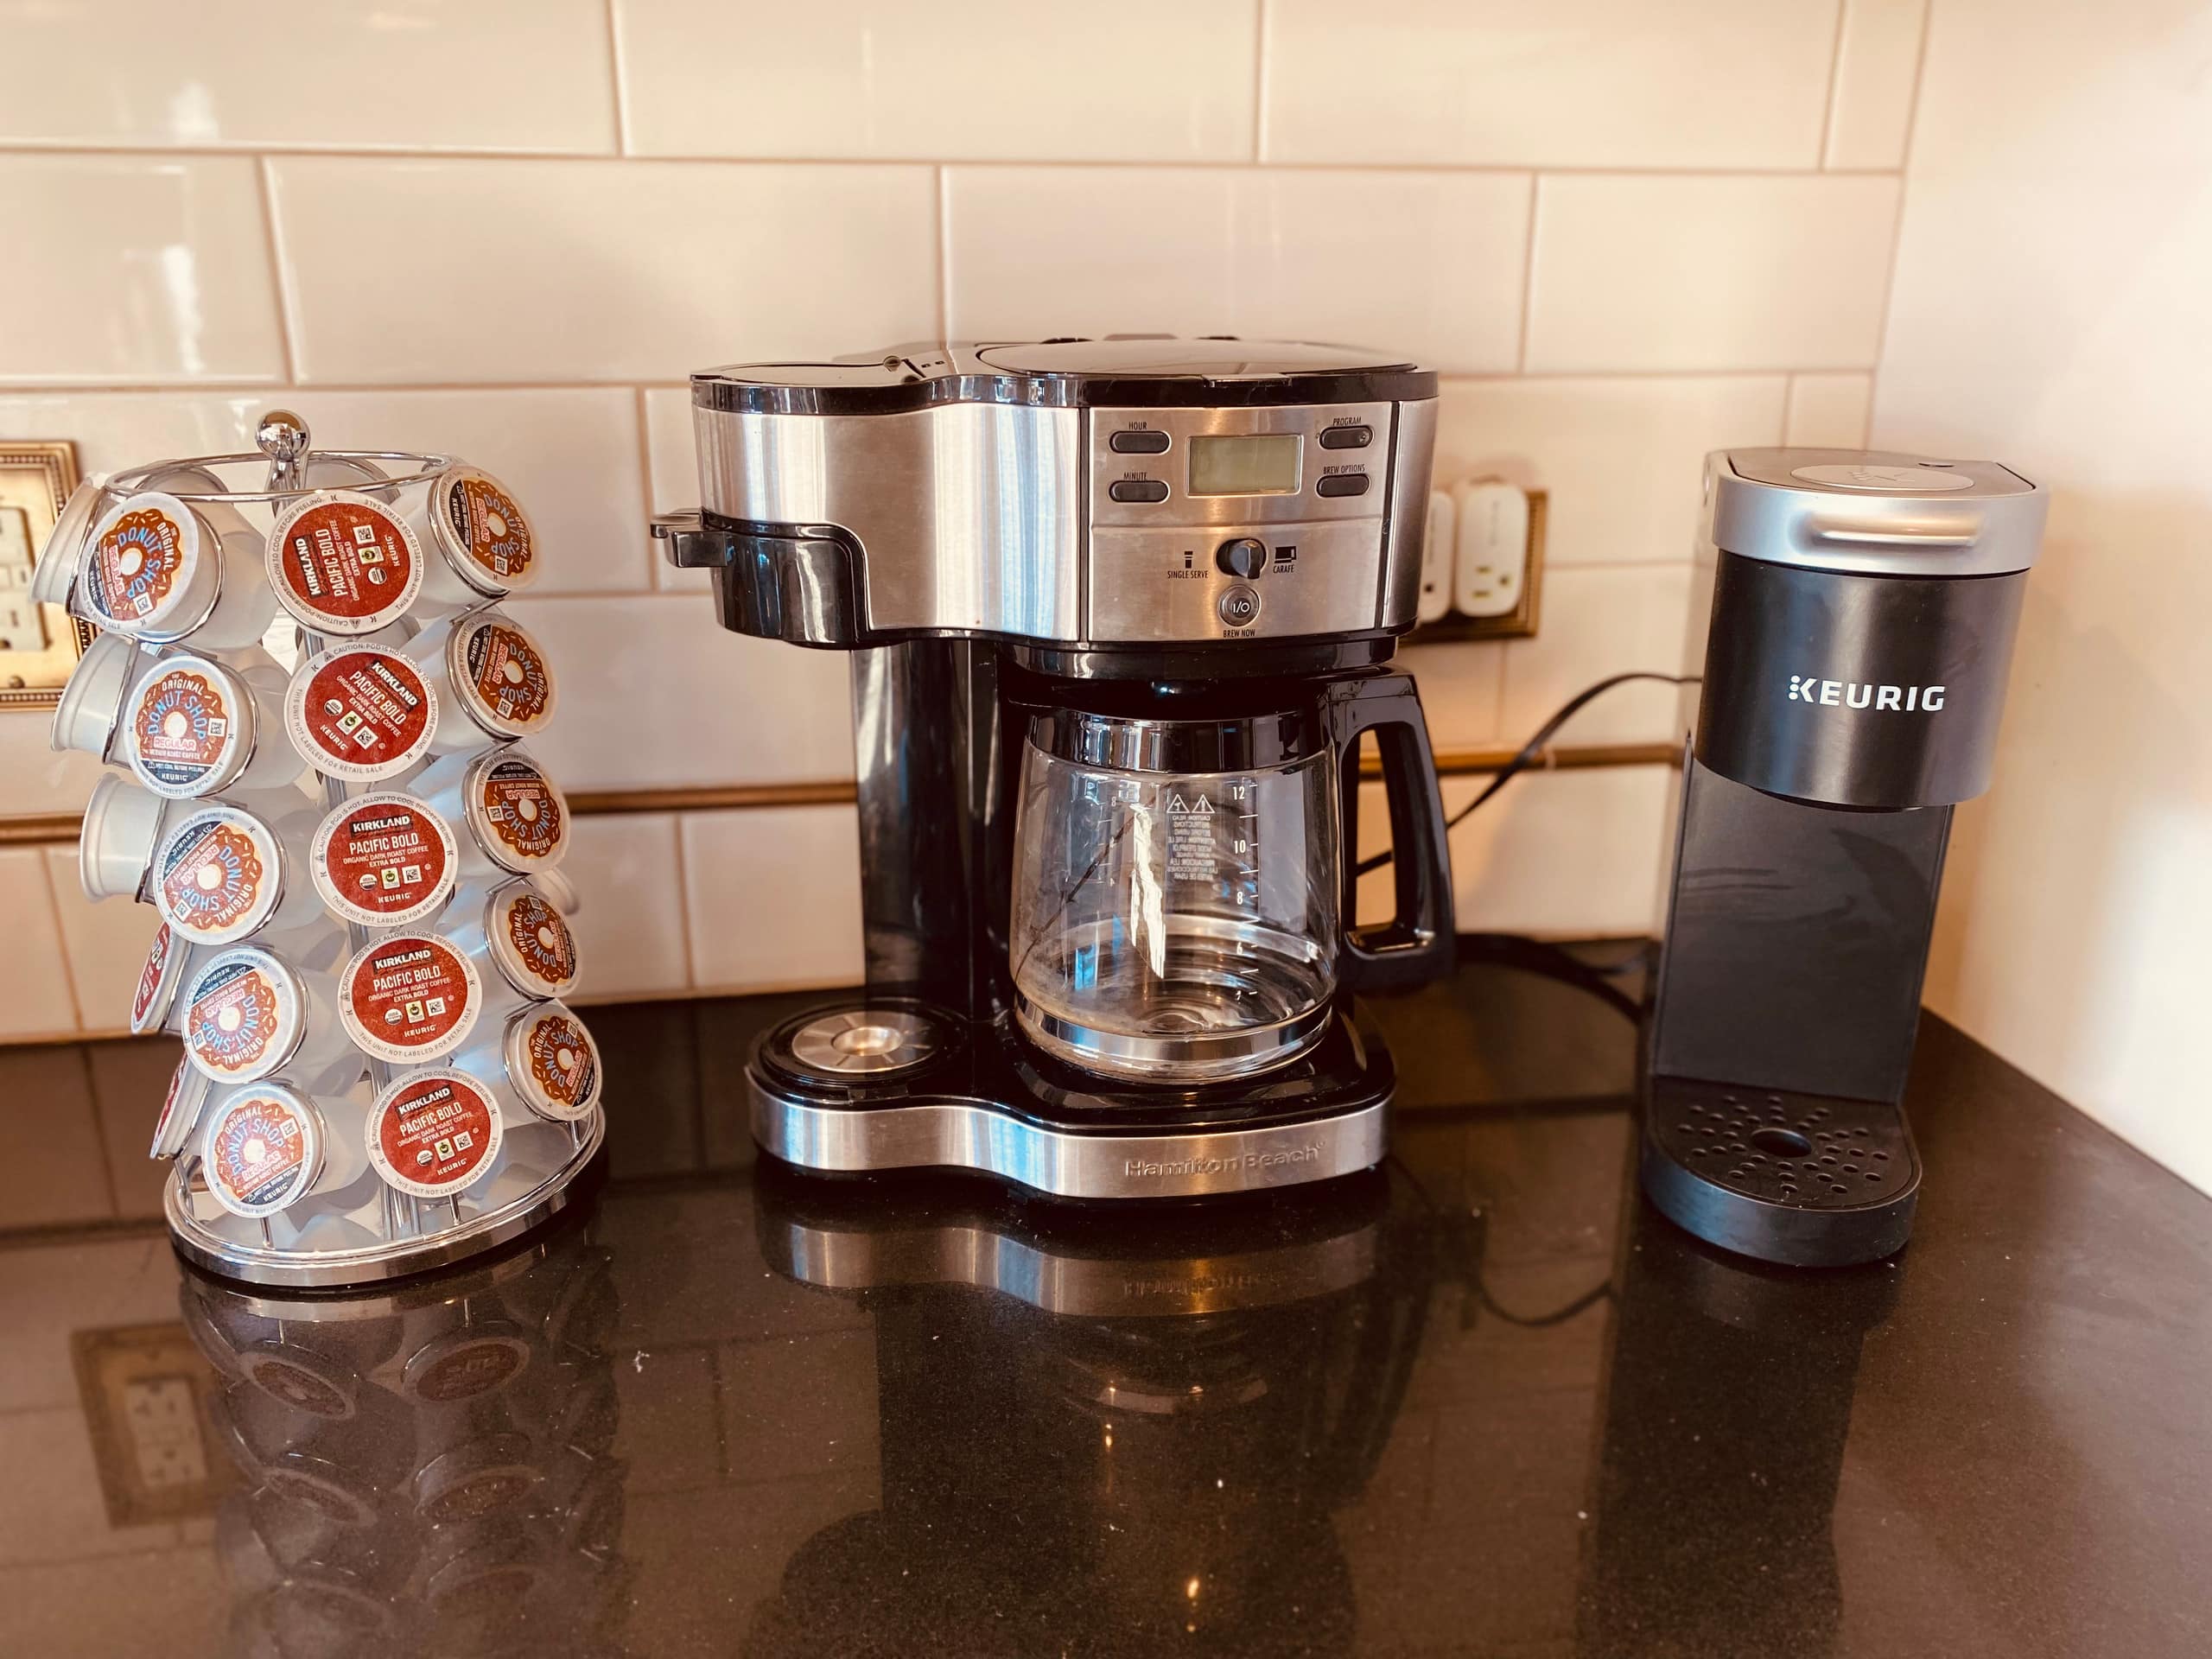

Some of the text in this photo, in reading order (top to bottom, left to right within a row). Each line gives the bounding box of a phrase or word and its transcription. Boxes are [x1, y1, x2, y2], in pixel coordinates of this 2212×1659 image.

[1129, 422, 1147, 430] HOUR
[1124, 472, 1147, 480] MINUTE
[484, 493, 520, 556] DONUT SHOP
[157, 522, 175, 571] ORIGINAL
[385, 535, 400, 566] KEURIG
[118, 526, 163, 599] DONUT SHOP
[296, 538, 321, 595] KIRKLAND
[315, 529, 347, 596] PACIFIC BOLD
[1191, 570, 1208, 579] SERVE
[493, 643, 508, 684] REGULAR
[499, 642, 537, 703] DONUT SHOP
[162, 679, 204, 695] ORIGINAL
[349, 671, 406, 724] PACIFIC BOLD
[372, 662, 417, 705] KIRKLAND
[531, 672, 543, 710] ORIGINAL
[1789, 676, 1946, 710] KEURIG
[148, 690, 207, 740] DONUT SHOP
[153, 736, 196, 751] REGULAR
[320, 724, 346, 750] KEURIG
[1233, 787, 1245, 800] 12
[353, 816, 410, 832] KIRKLAND
[502, 800, 550, 841] DONUT SHOP
[349, 833, 418, 855] PACIFIC BOLD
[518, 837, 550, 850] ORIGINAL
[1235, 841, 1246, 853] 10
[180, 843, 219, 885] REGULAR
[219, 847, 242, 902] DONUT
[181, 888, 220, 911] SHOP
[213, 884, 252, 922] ORIGINAL
[378, 893, 410, 903] KEURIG
[1237, 892, 1243, 904] 8
[514, 912, 528, 953] ORIGINAL
[524, 910, 556, 967] DONUT SHOP
[376, 950, 430, 969] KIRKLAND
[373, 966, 441, 992] PACIFIC BOLD
[393, 989, 429, 1002] EXTRA BOLD
[202, 995, 258, 1052] DONUT SHOP
[404, 1025, 435, 1037] KEURIG
[223, 1036, 264, 1065] ORIGINAL
[534, 1024, 553, 1058] ORIGINAL
[543, 1031, 578, 1087] DONUT SHOP
[398, 1088, 450, 1115] KIRKLAND
[225, 1107, 262, 1134] ORIGINAL
[400, 1102, 462, 1136] PACIFIC BOLD
[228, 1118, 283, 1175] DONUT SHOP
[1126, 1146, 1318, 1176] Hamilton Beach
[437, 1159, 467, 1175] KEURIG
